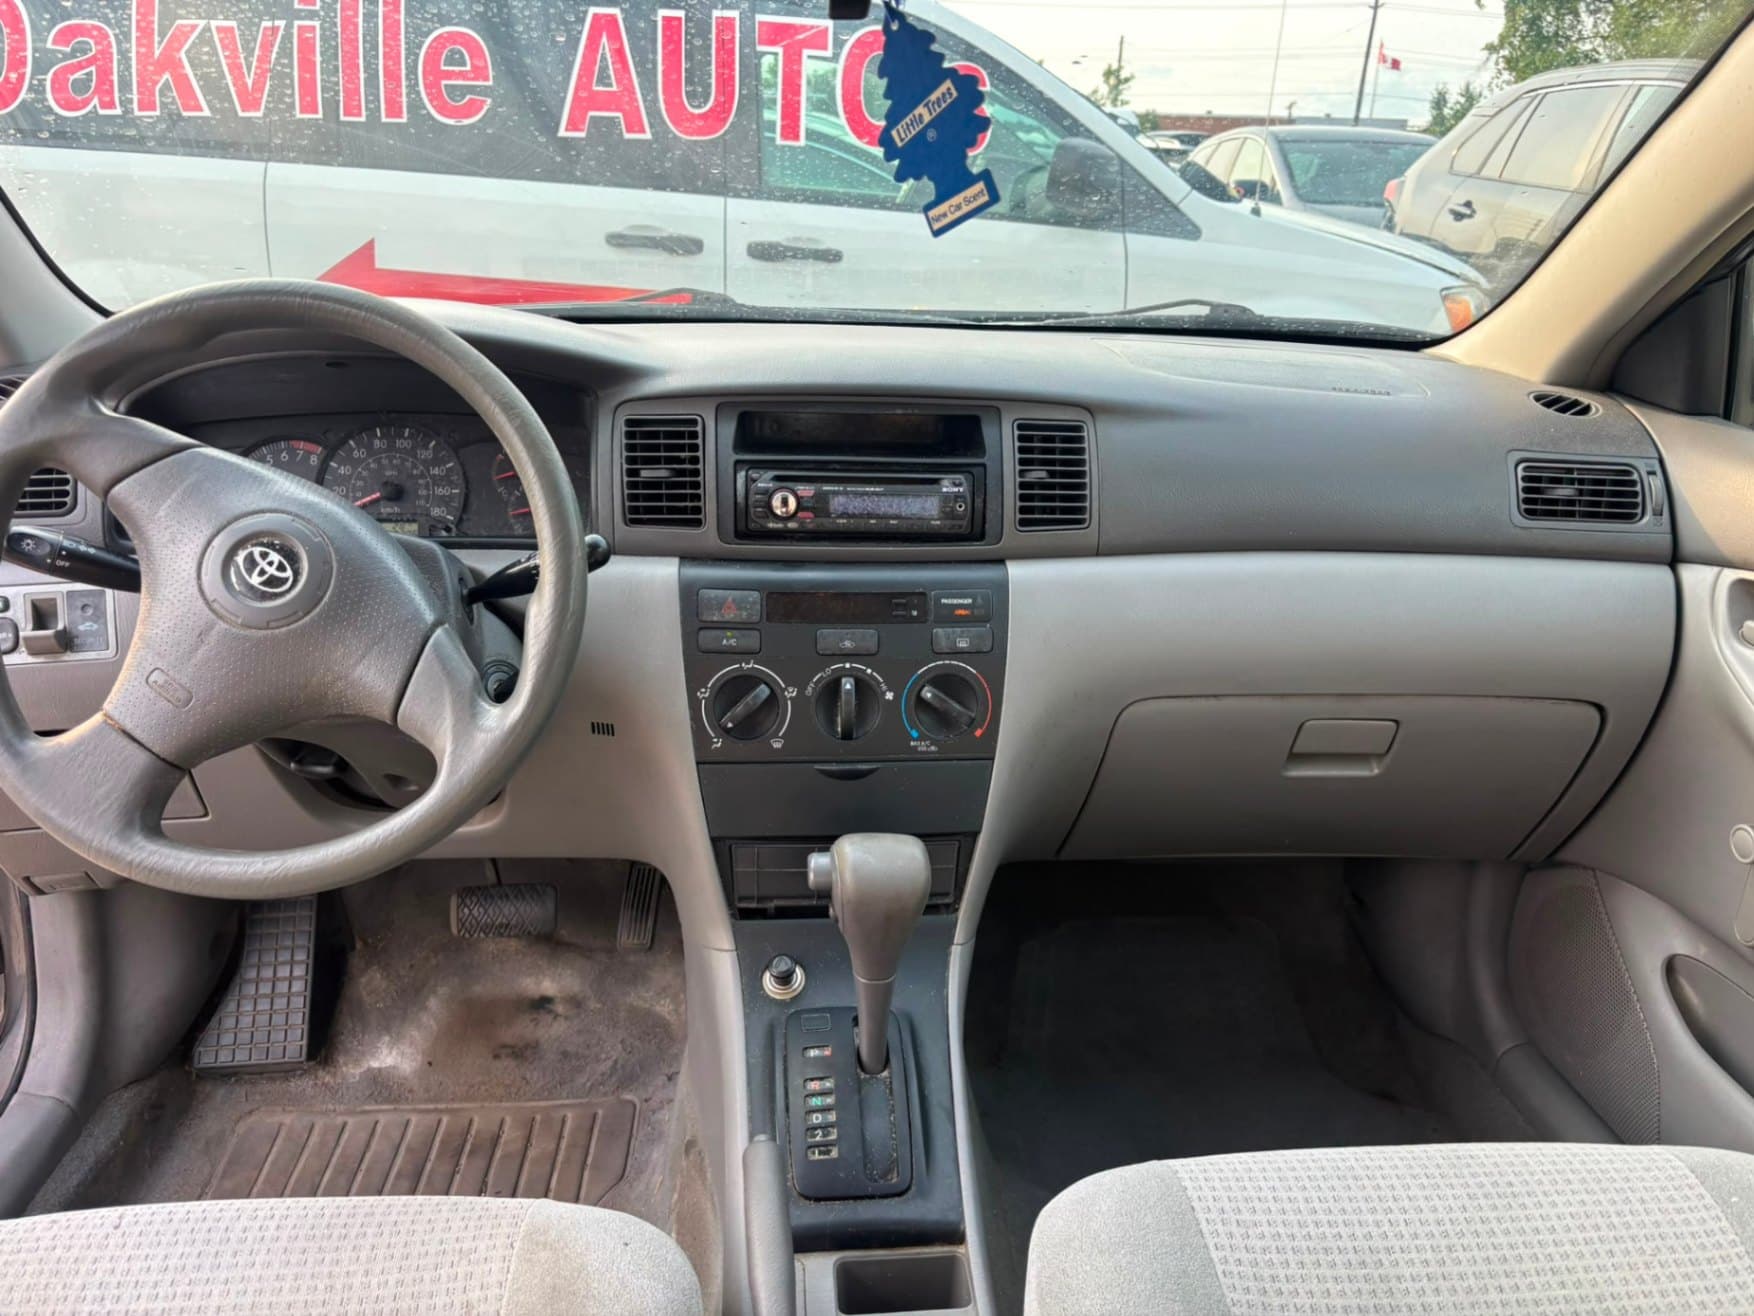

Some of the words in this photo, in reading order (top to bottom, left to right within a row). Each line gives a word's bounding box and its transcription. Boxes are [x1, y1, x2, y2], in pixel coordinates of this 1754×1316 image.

[895, 112, 925, 143] Little
[922, 86, 954, 117] Trees
[930, 210, 949, 225] New
[948, 201, 963, 215] Car
[962, 188, 987, 207] Scent
[373, 439, 388, 449] 80
[395, 439, 412, 449] 100
[280, 450, 289, 461] 6
[296, 450, 304, 462] 7
[352, 449, 367, 459] 60
[417, 449, 433, 459] 120
[310, 454, 318, 465] 8
[338, 466, 352, 476] 40
[429, 465, 446, 476] 140
[434, 486, 451, 496] 160
[429, 506, 447, 517] 180
[722, 638, 737, 646] A/C
[812, 1096, 822, 1105] N
[812, 1113, 822, 1123] D
[814, 1129, 822, 1140] 2
